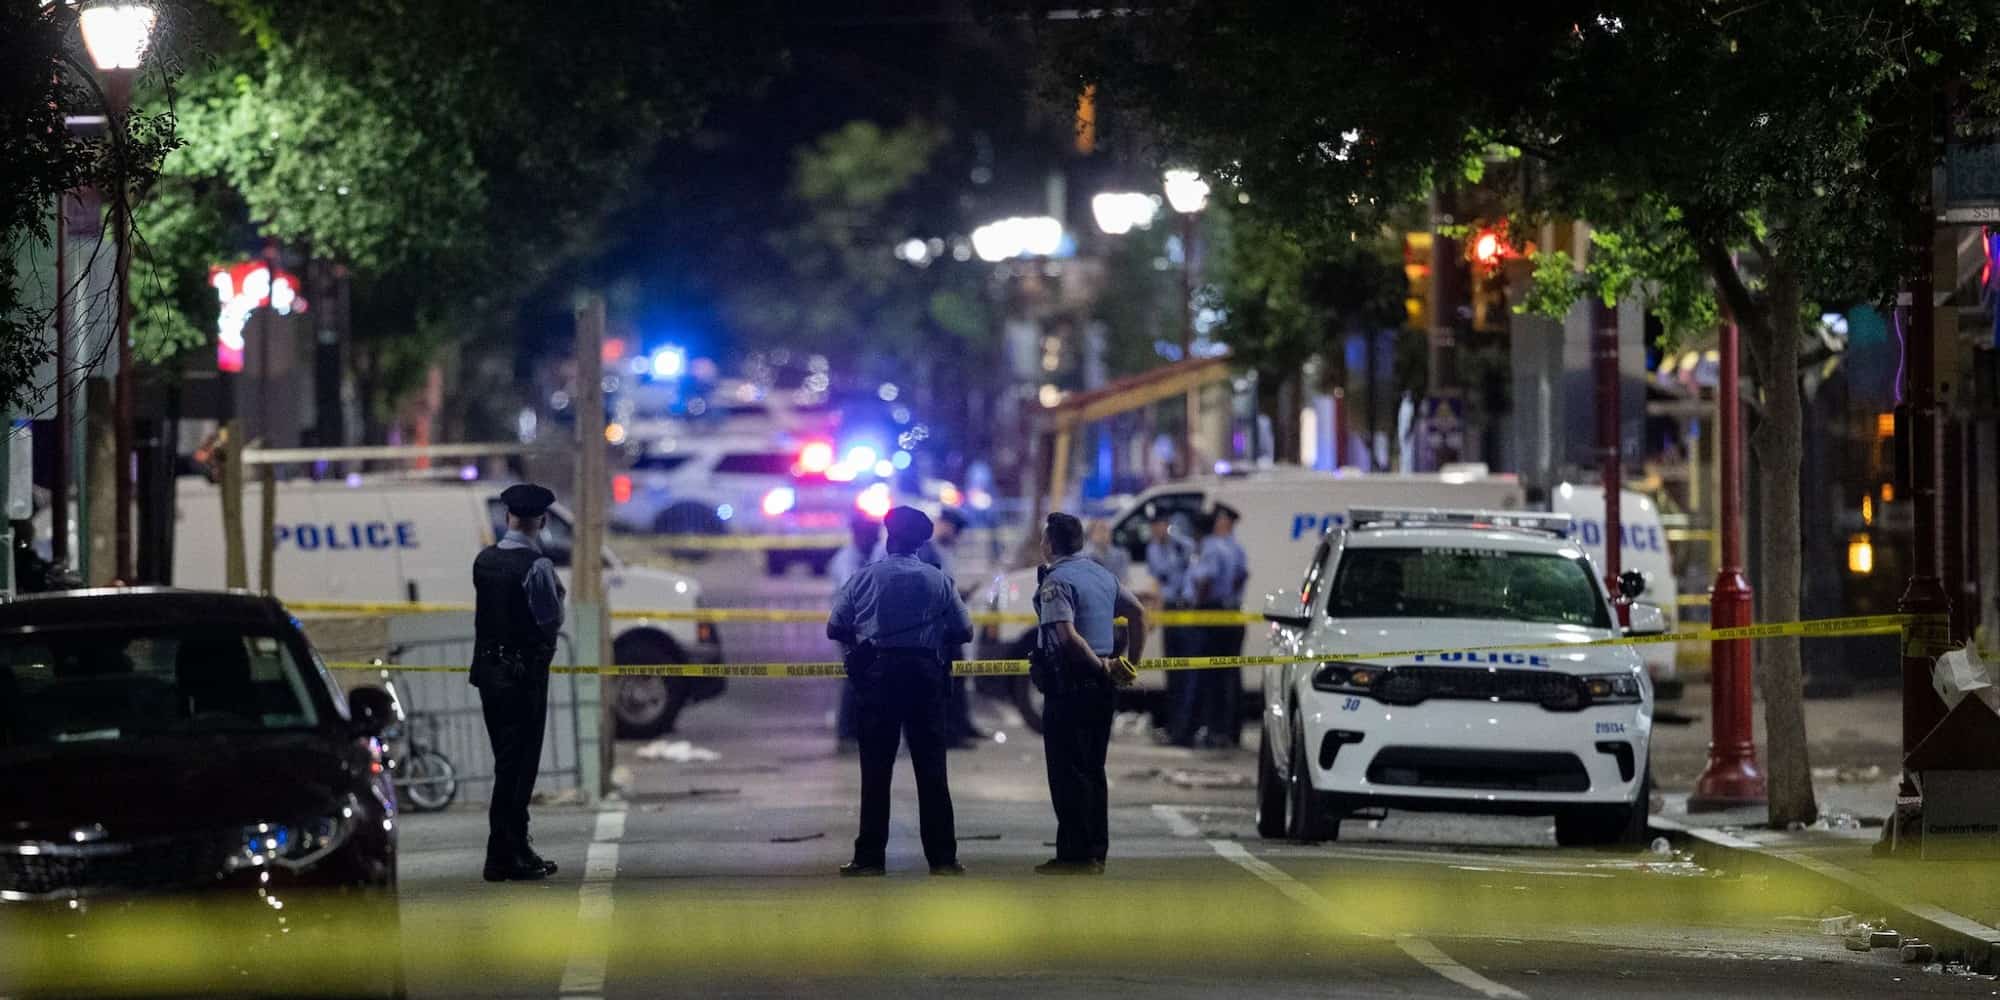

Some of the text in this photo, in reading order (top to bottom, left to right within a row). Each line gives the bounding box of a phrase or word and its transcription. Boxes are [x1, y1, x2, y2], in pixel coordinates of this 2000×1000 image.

[273, 521, 420, 551] POLICE
[1564, 518, 1660, 551] POICE
[956, 663, 973, 673] POLICE
[975, 663, 984, 673] LINE
[985, 663, 992, 673] DO
[993, 662, 1002, 672] NOT
[1342, 697, 1361, 712] 30
